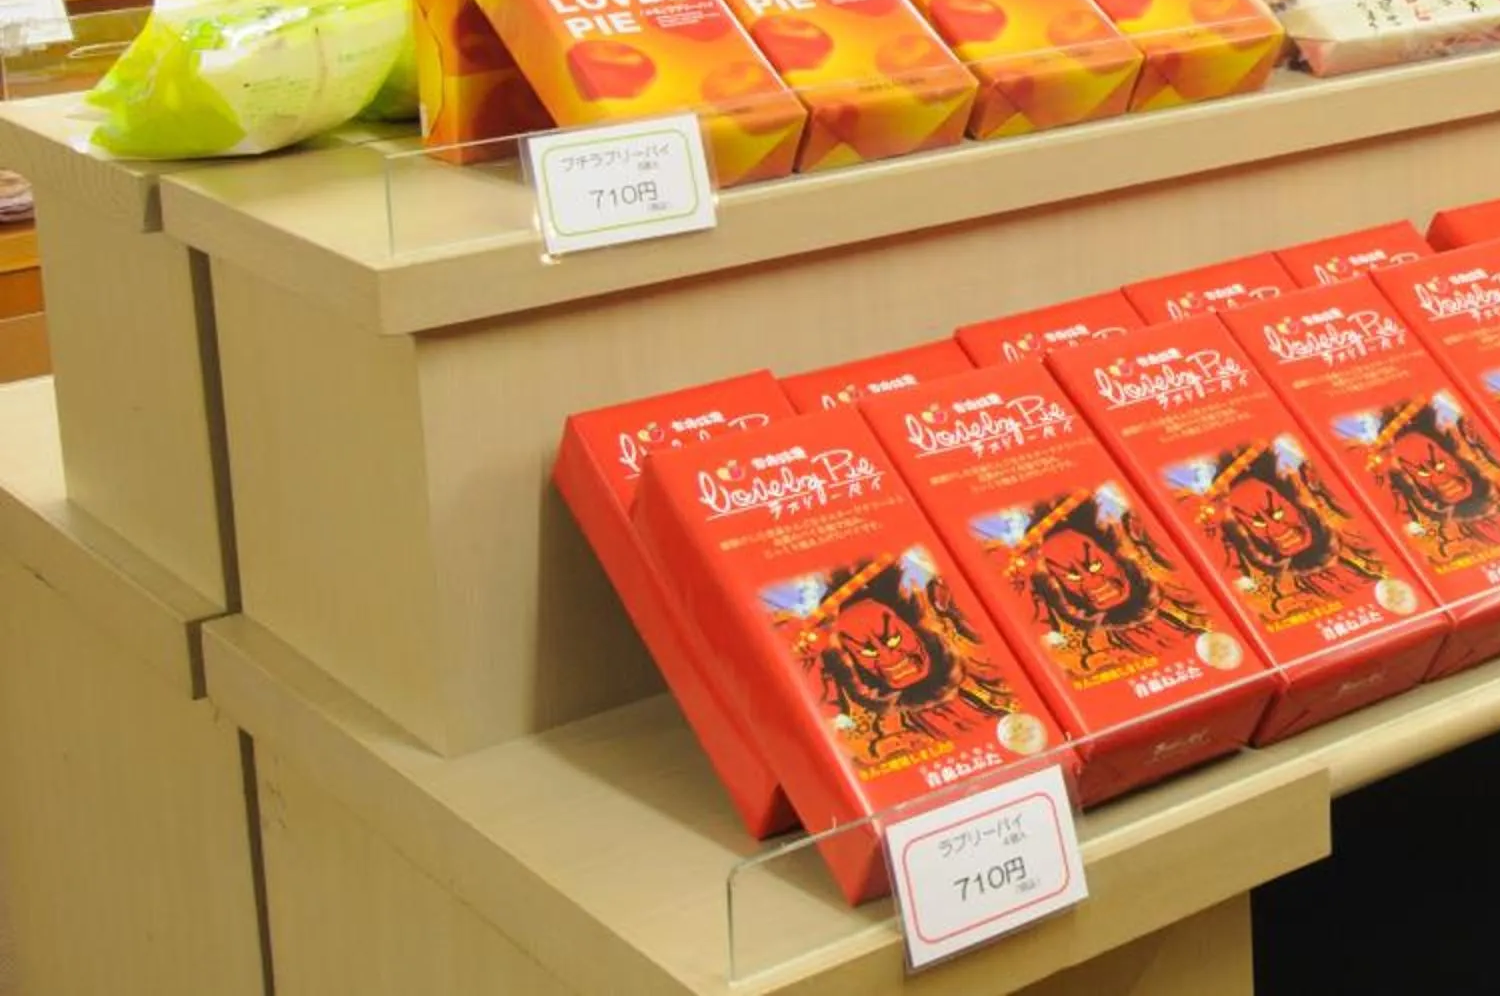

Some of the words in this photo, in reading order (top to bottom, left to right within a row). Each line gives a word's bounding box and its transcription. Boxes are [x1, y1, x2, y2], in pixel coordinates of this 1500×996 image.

[563, 11, 642, 40] PIE
[588, 180, 659, 212] 710円
[937, 812, 1023, 859] ラブリーパイ
[953, 855, 1027, 902] 710円
